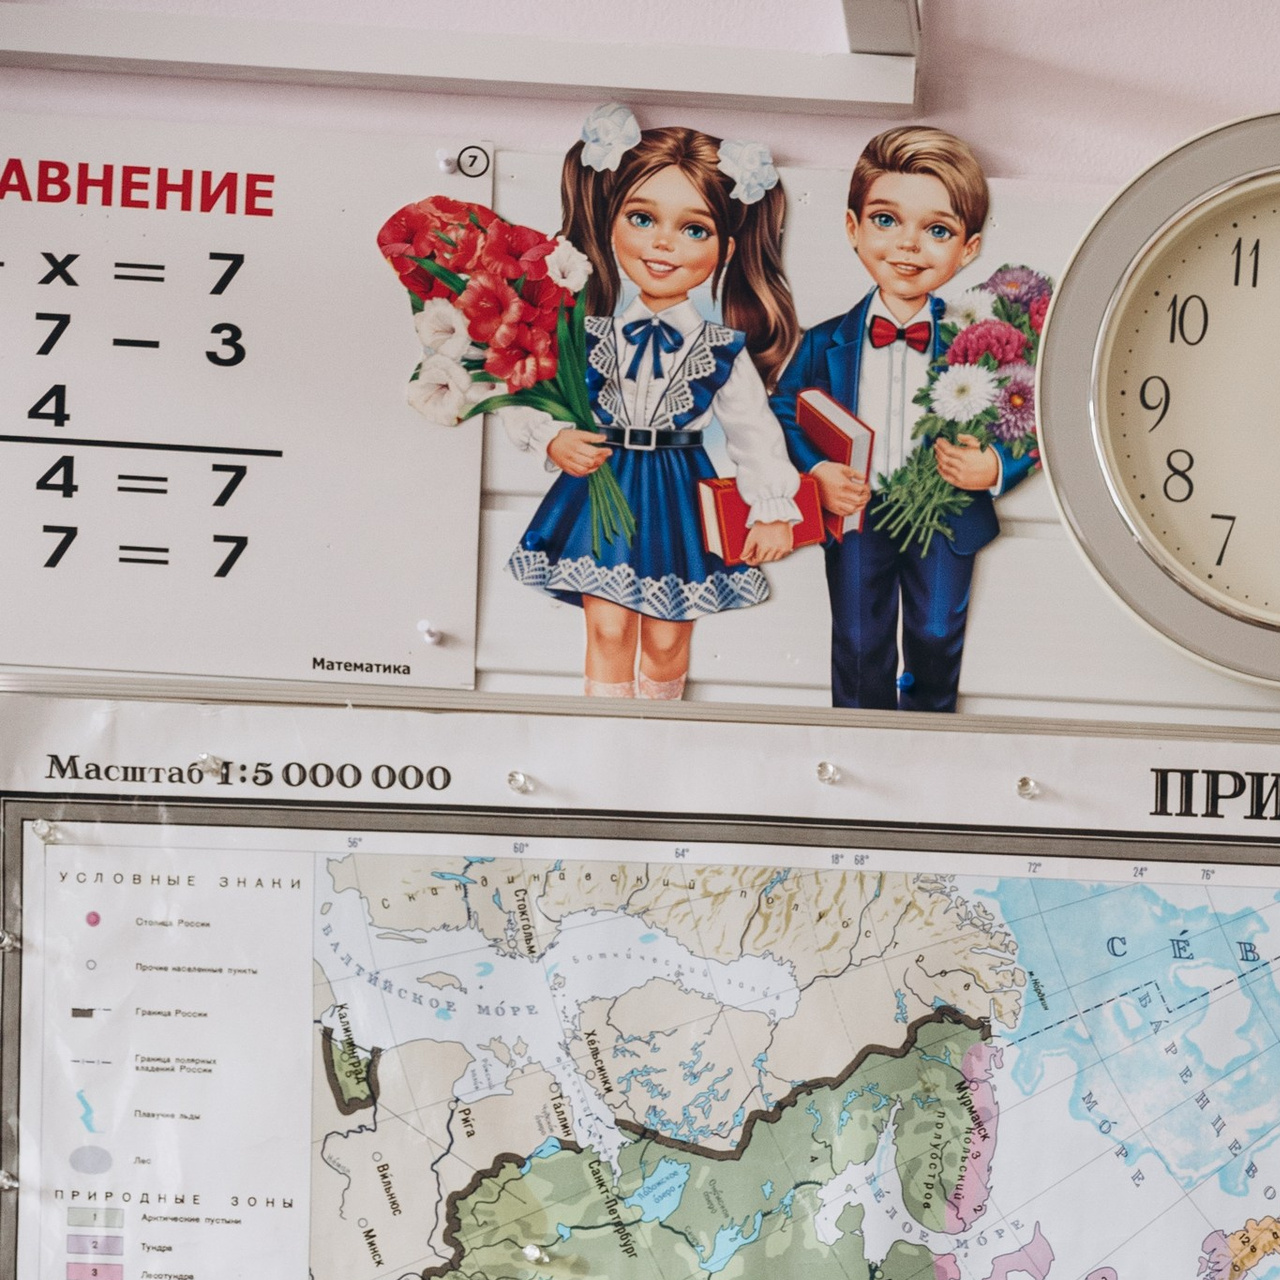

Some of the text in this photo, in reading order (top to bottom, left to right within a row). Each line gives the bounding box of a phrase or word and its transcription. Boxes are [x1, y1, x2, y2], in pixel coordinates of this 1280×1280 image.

[467, 156, 479, 167] 7
[208, 253, 245, 295] 7
[1231, 237, 1260, 288] 11
[34, 313, 71, 356] 7
[205, 323, 247, 367] 3
[1167, 293, 1209, 346] 10
[27, 384, 71, 427] 4
[1139, 375, 1171, 433] 9
[35, 455, 79, 498] 4
[211, 464, 248, 507] 7
[1163, 449, 1194, 502] 8
[42, 525, 79, 569] 7
[213, 535, 249, 578] 7
[1211, 513, 1237, 566] 7
[311, 656, 411, 675] Математика
[44, 753, 204, 785] Масштаб
[59, 871, 301, 889] УСЛОВНЫЕ ЗНАКИ
[54, 1190, 293, 1208] ПРИРОДНЫЕ ЗОНЫ
[362, 1228, 385, 1268] Минск
[91, 1269, 98, 1277] 3
